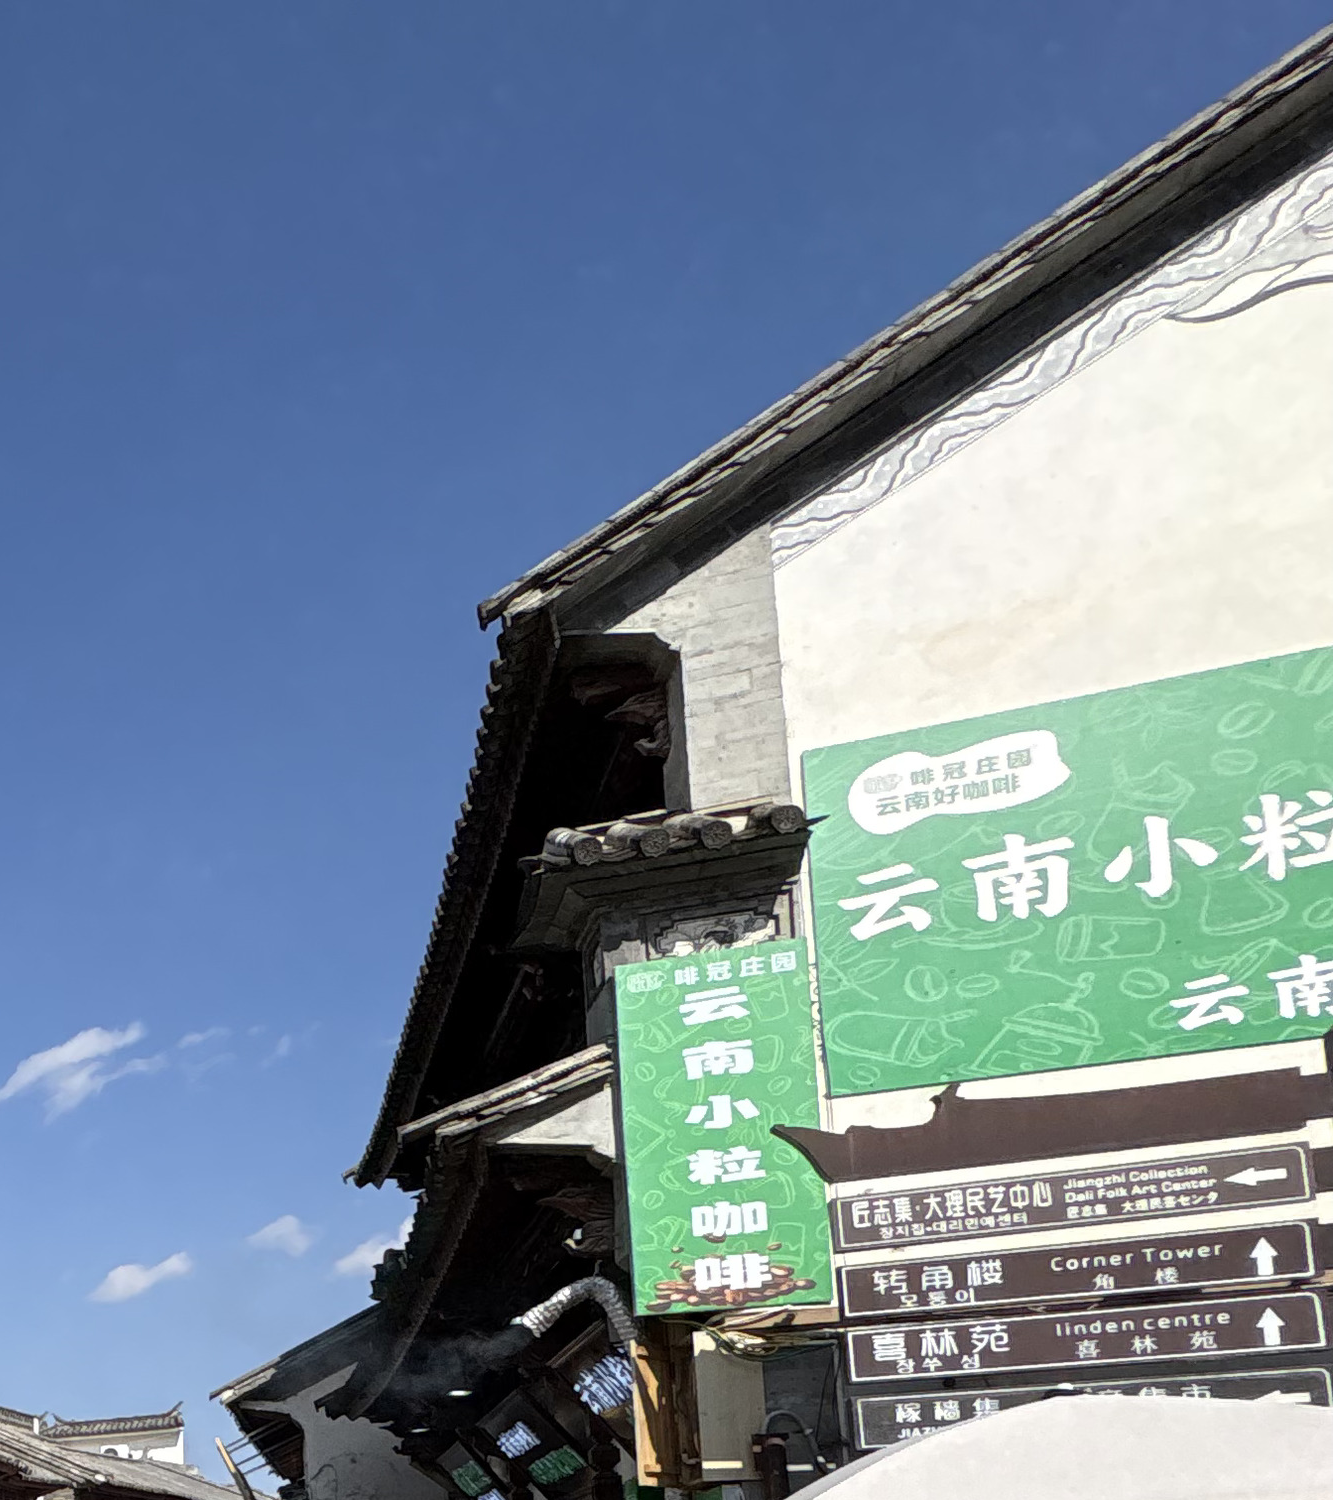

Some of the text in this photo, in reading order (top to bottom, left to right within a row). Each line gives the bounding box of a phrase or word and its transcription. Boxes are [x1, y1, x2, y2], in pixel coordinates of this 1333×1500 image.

[909, 747, 1033, 787] 啡冠庄园
[875, 772, 1021, 817] 云南好咖啡
[837, 789, 1333, 942] 云南小粒
[674, 950, 797, 986] 啡冠庄园
[1170, 954, 1333, 1031] 云南
[679, 985, 773, 1290] 云南小粒咖啡
[1097, 1185, 1129, 1200] Folk
[1132, 1182, 1158, 1196] Art
[1129, 1164, 1209, 1183] Collection
[1050, 1243, 1224, 1272] Corner Tower
[871, 1258, 1005, 1296] 转角楼
[871, 1323, 1011, 1362] 喜林苑
[1055, 1311, 1232, 1337] linden centre
